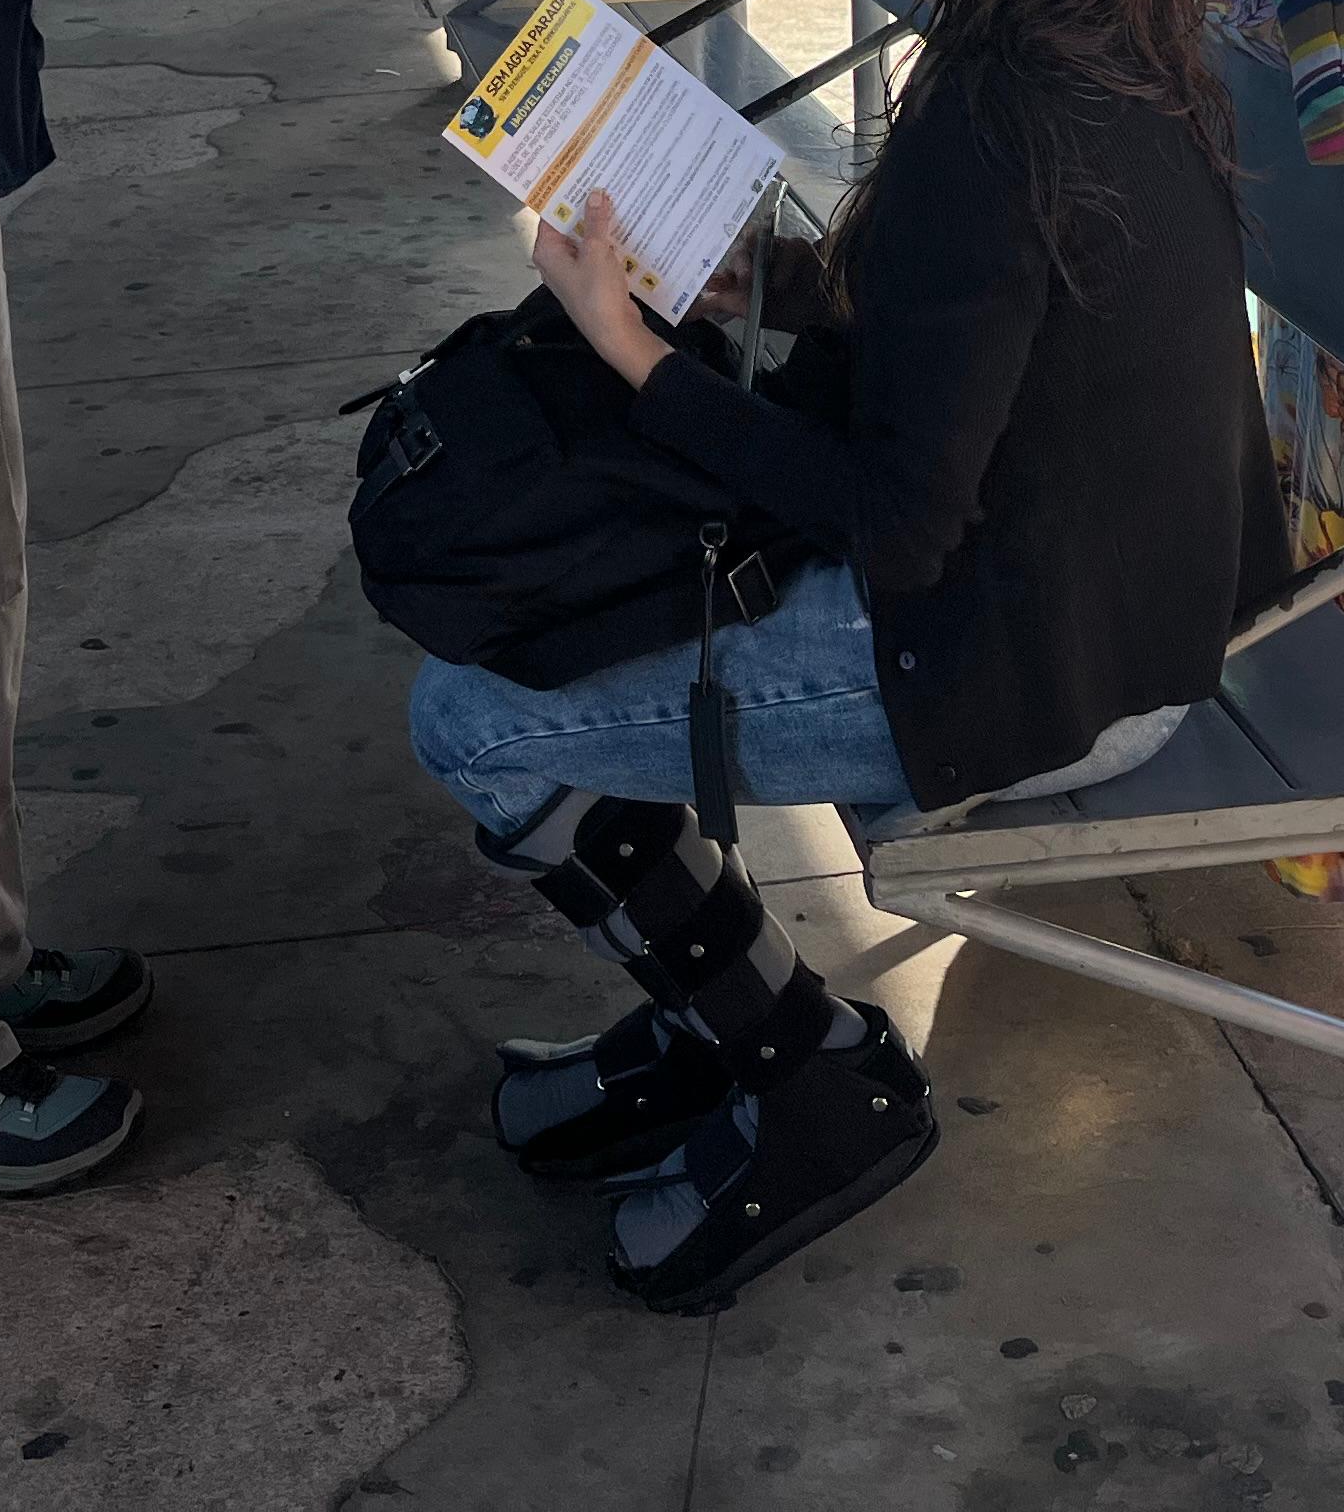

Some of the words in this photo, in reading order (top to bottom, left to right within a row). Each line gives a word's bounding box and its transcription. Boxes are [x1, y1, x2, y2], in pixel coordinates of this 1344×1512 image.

[485, 68, 511, 97] SEM
[501, 36, 534, 74] ÁGUA
[508, 90, 541, 129] IMÓVEL
[536, 46, 575, 94] FECHADO
